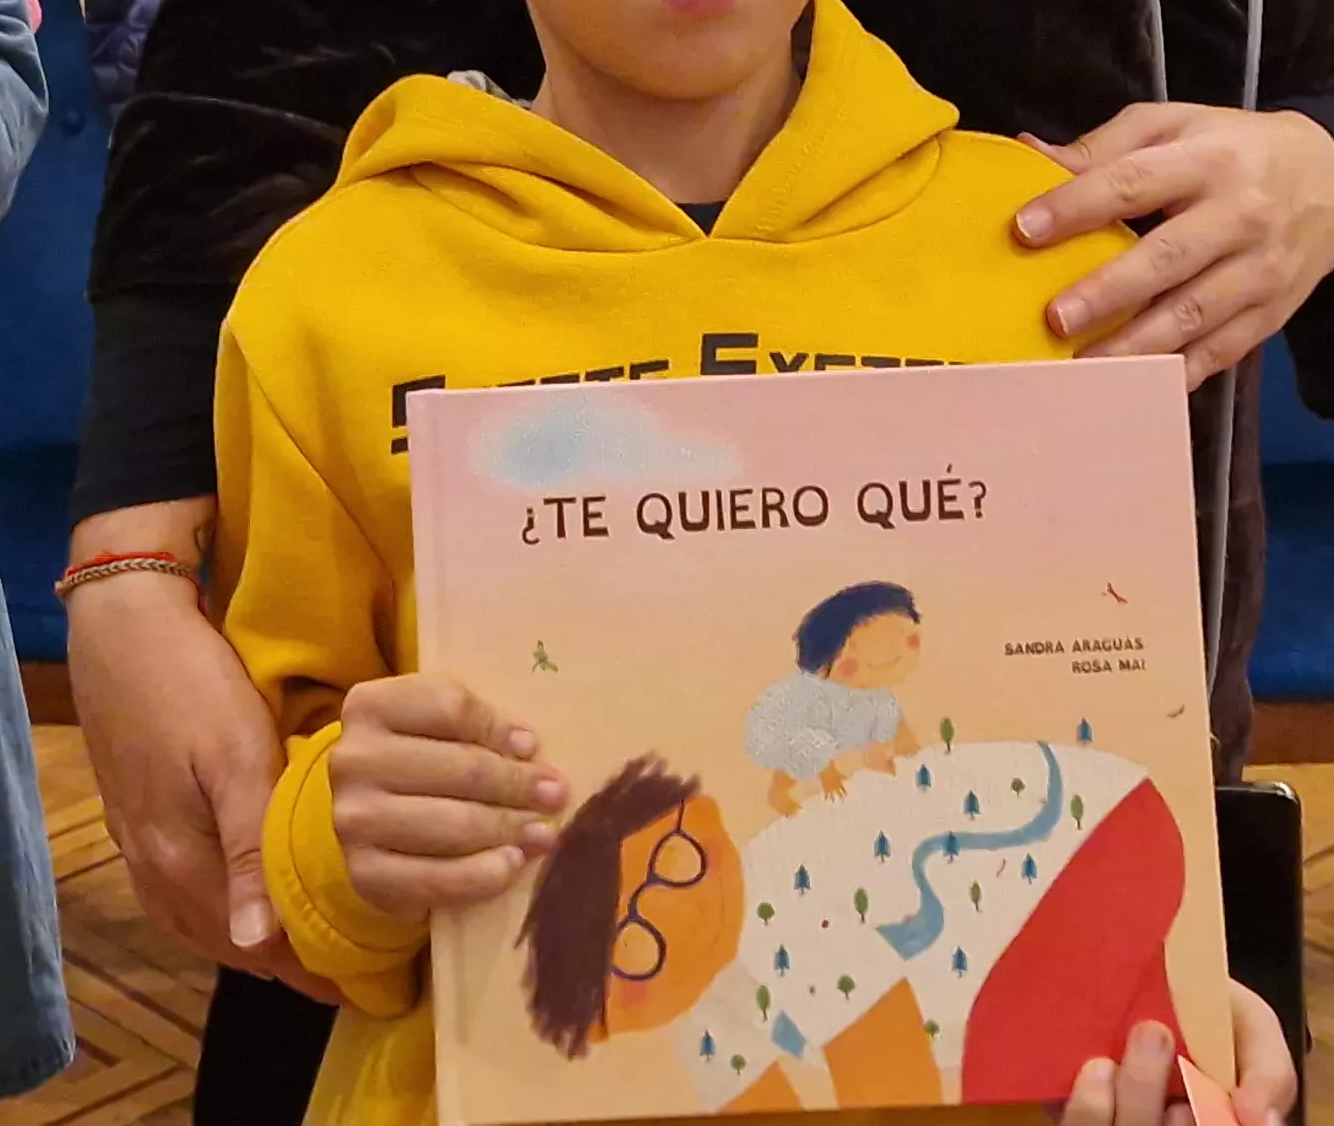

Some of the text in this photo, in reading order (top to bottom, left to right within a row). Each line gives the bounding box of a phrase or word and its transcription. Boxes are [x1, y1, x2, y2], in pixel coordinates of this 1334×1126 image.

[521, 464, 988, 546] ¿TE QUIERO QUÉ?
[1004, 640, 1065, 656] SANDRA
[1071, 659, 1113, 674] ROSA
